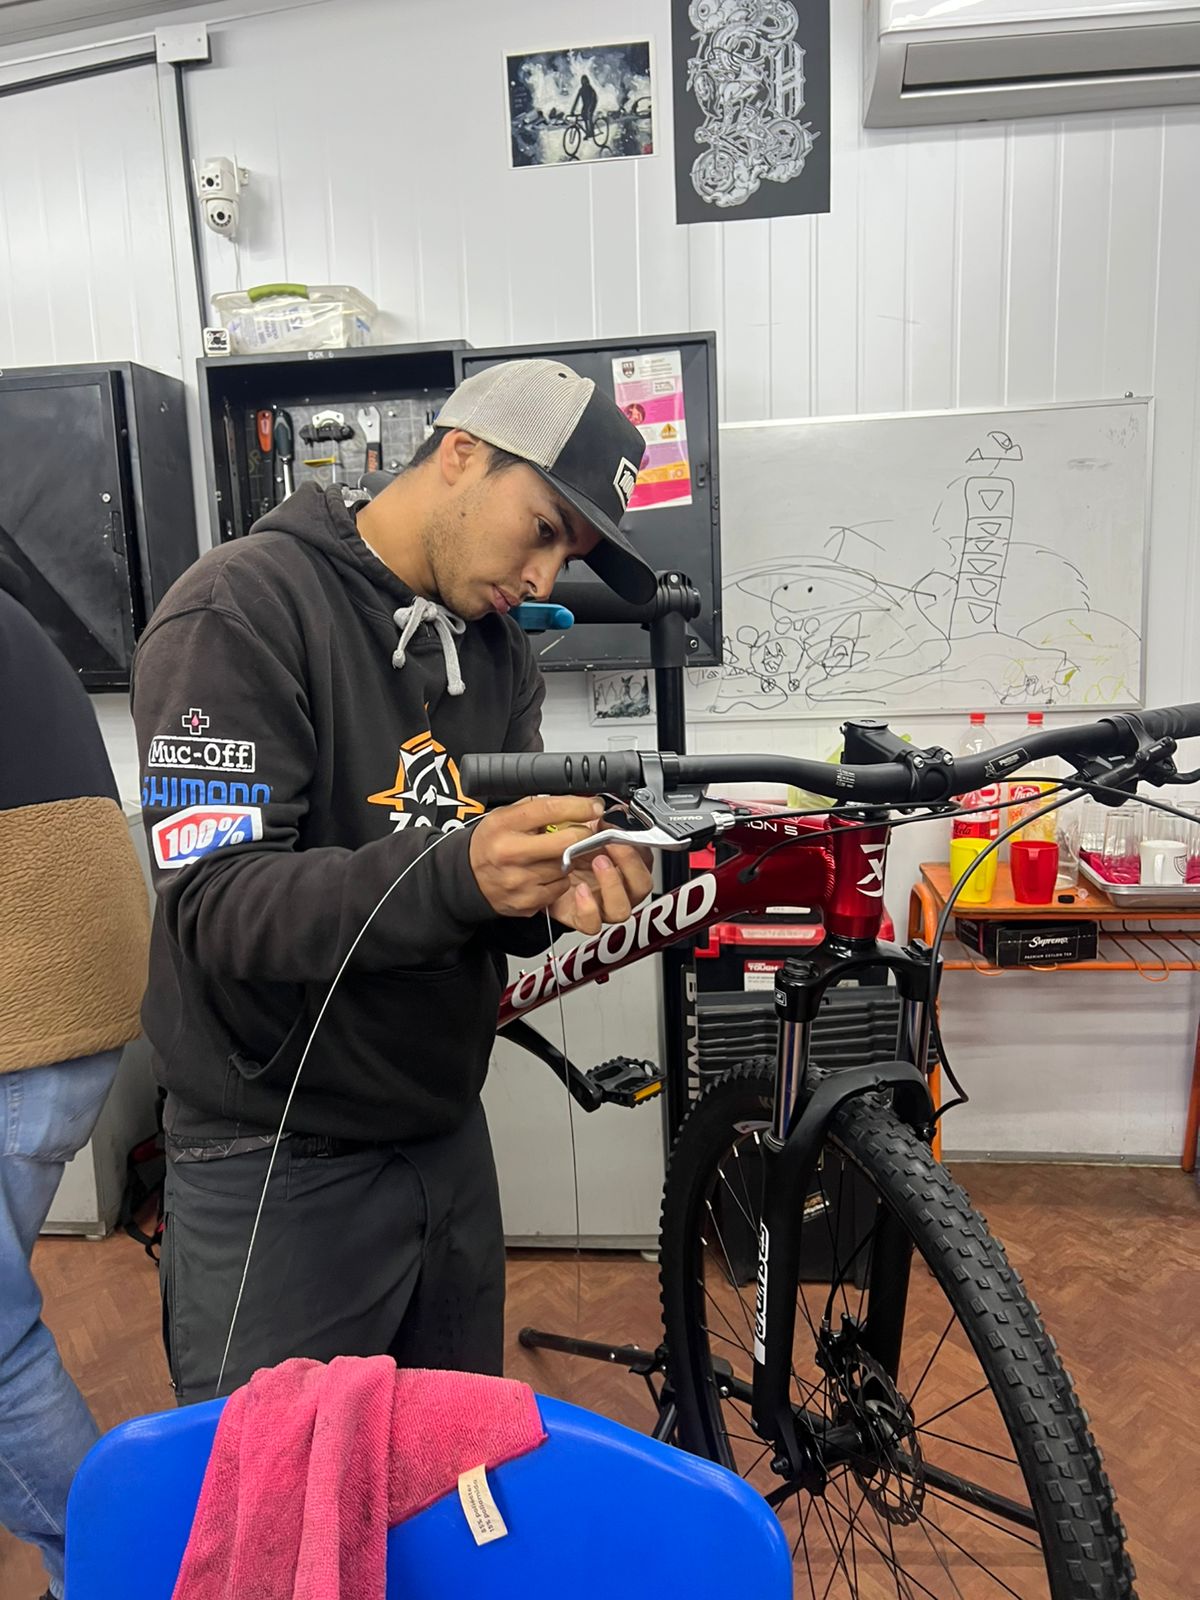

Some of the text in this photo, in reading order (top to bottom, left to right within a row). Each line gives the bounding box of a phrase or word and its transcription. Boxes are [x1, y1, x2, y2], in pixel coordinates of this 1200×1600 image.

[151, 740, 252, 769] Muc-Off
[165, 815, 245, 859] 100%
[511, 873, 717, 1009] OXFORD
